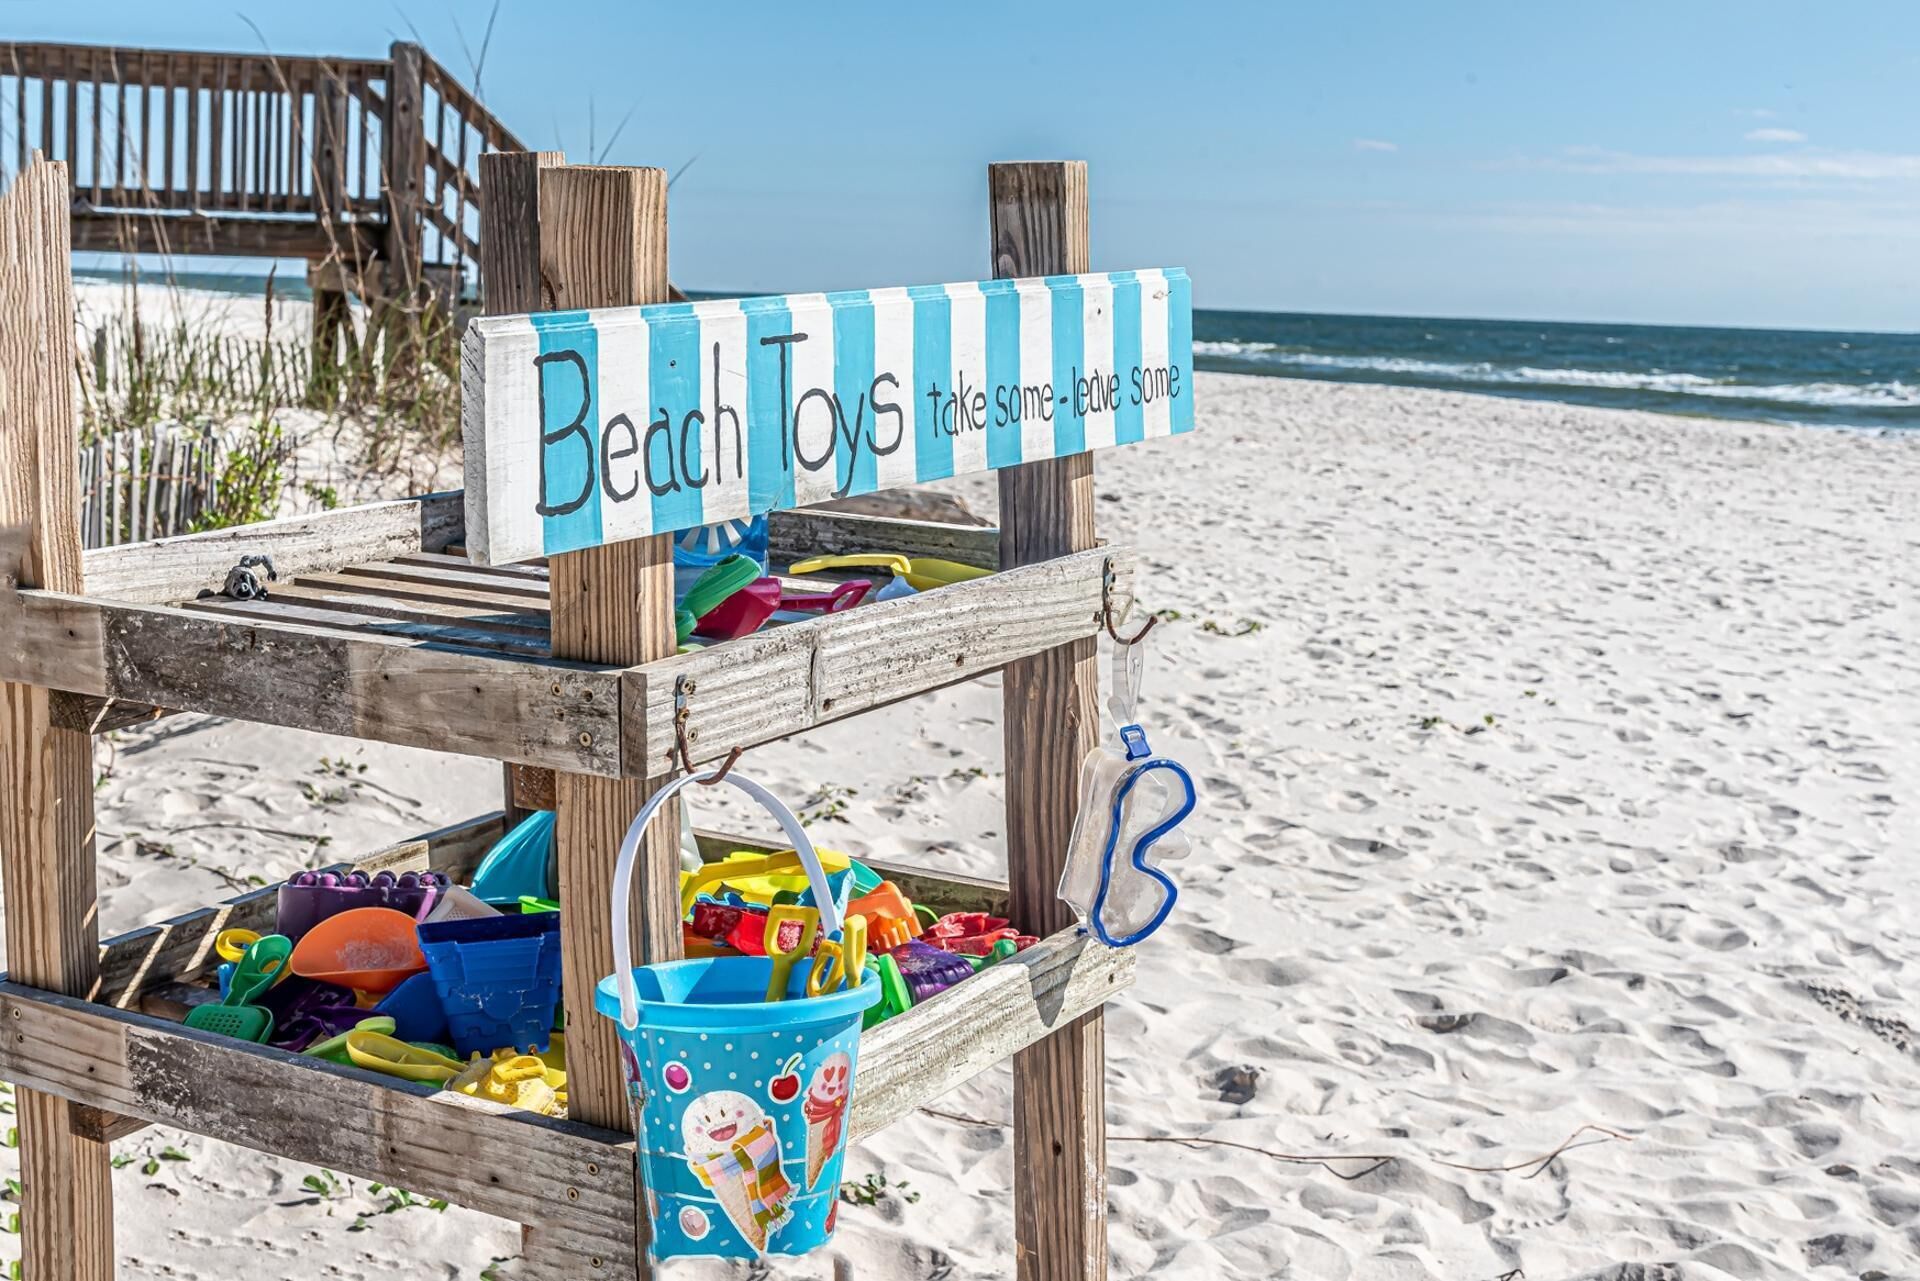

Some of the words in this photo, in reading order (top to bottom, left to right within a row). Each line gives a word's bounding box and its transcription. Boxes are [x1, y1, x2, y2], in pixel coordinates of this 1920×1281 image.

[533, 341, 743, 517] Beach
[760, 332, 904, 499] Toys
[927, 370, 987, 438] take
[1131, 364, 1180, 406] some
